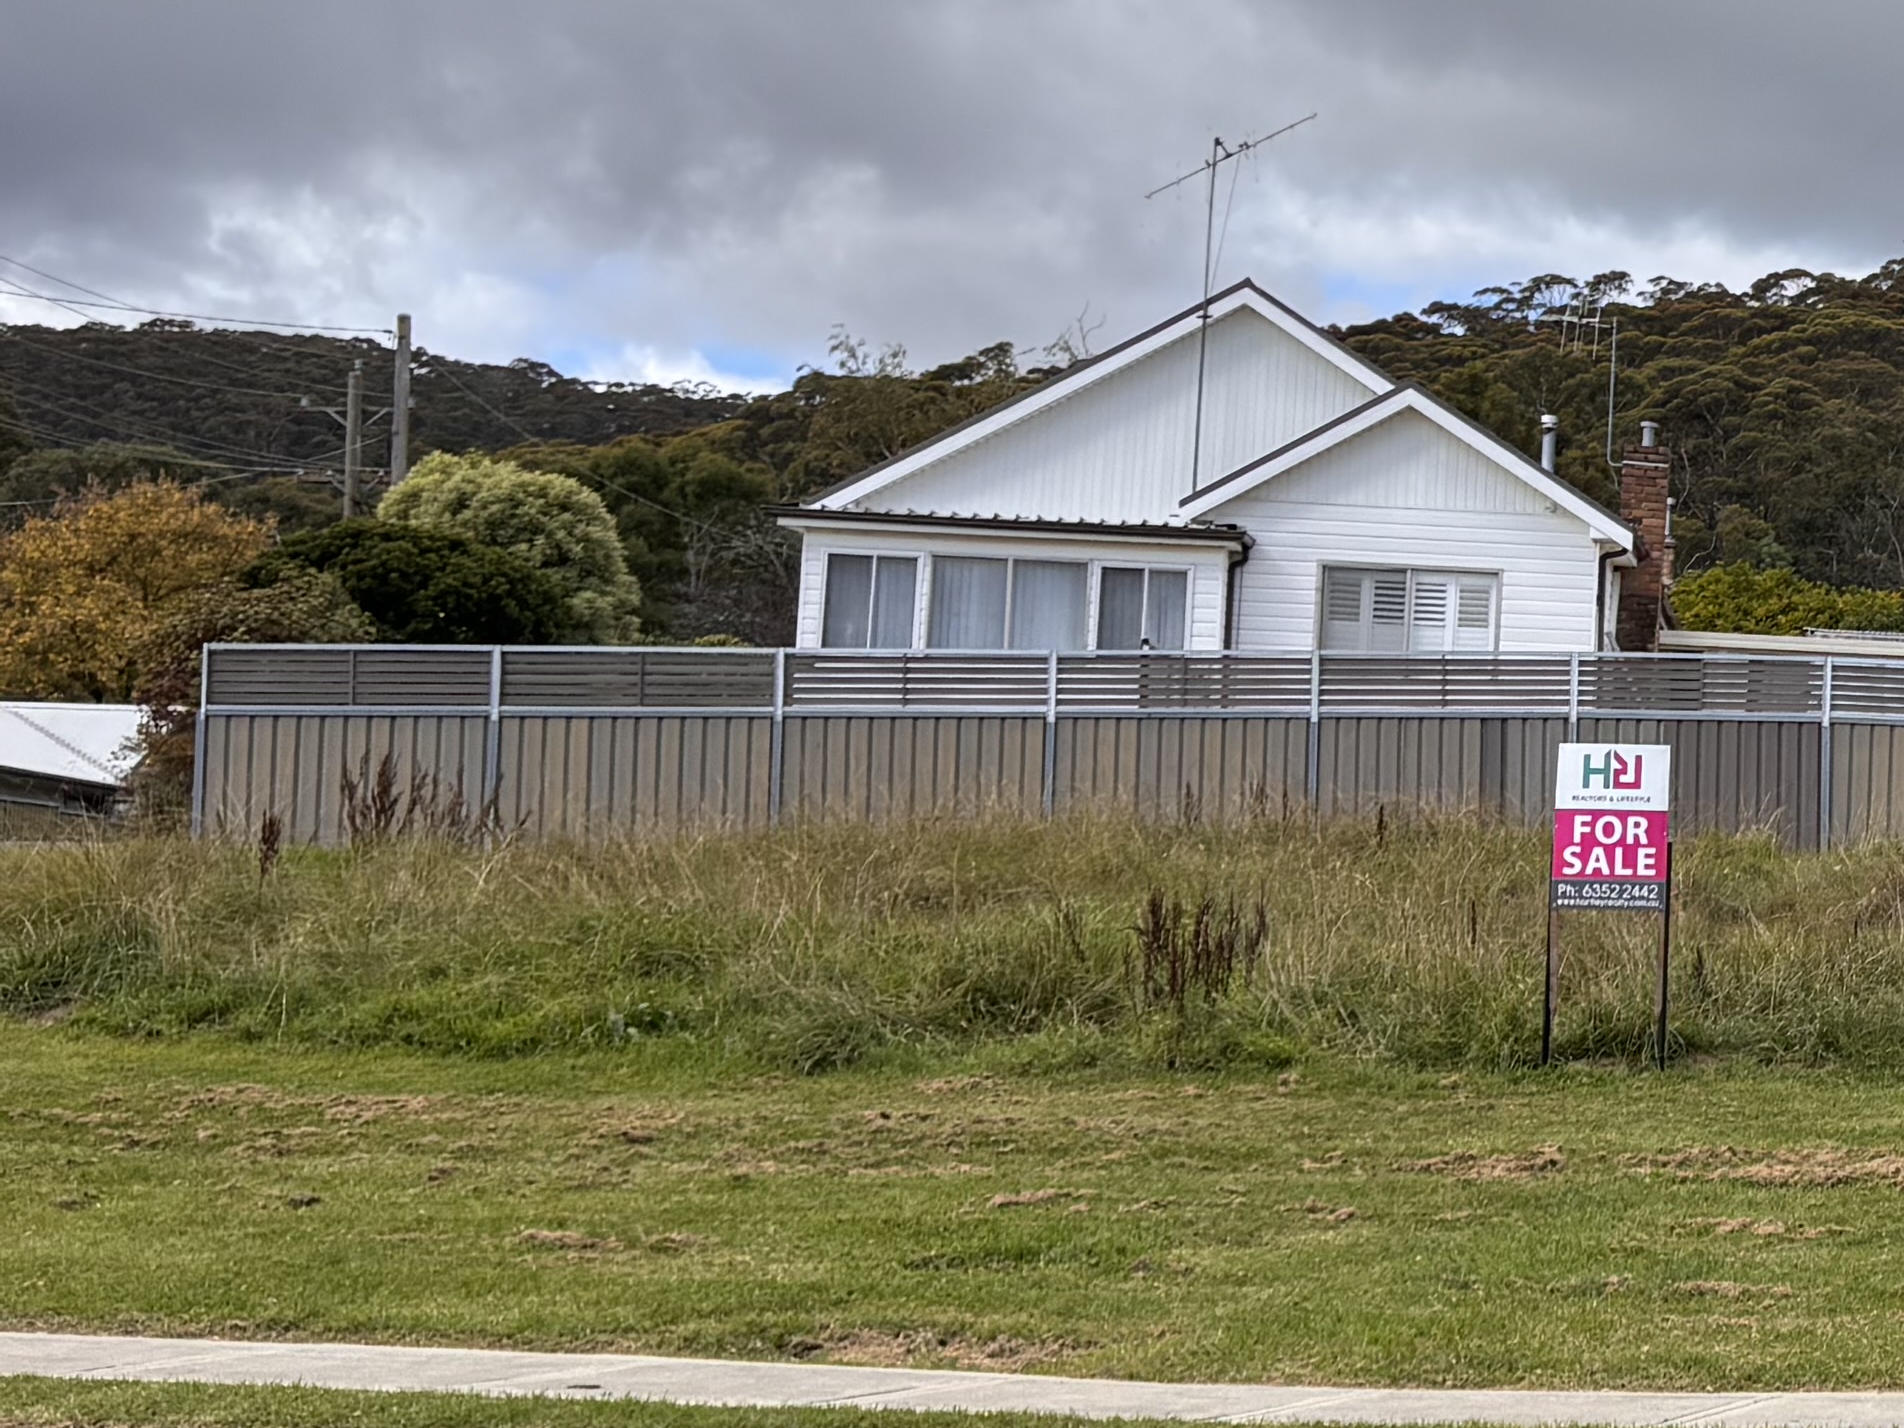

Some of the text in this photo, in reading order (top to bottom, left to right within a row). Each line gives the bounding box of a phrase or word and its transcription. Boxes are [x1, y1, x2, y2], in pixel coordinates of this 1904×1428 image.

[1573, 815, 1649, 845] FOR
[1562, 845, 1657, 876] SALE
[1557, 883, 1659, 899] Ph: 6352 2442
